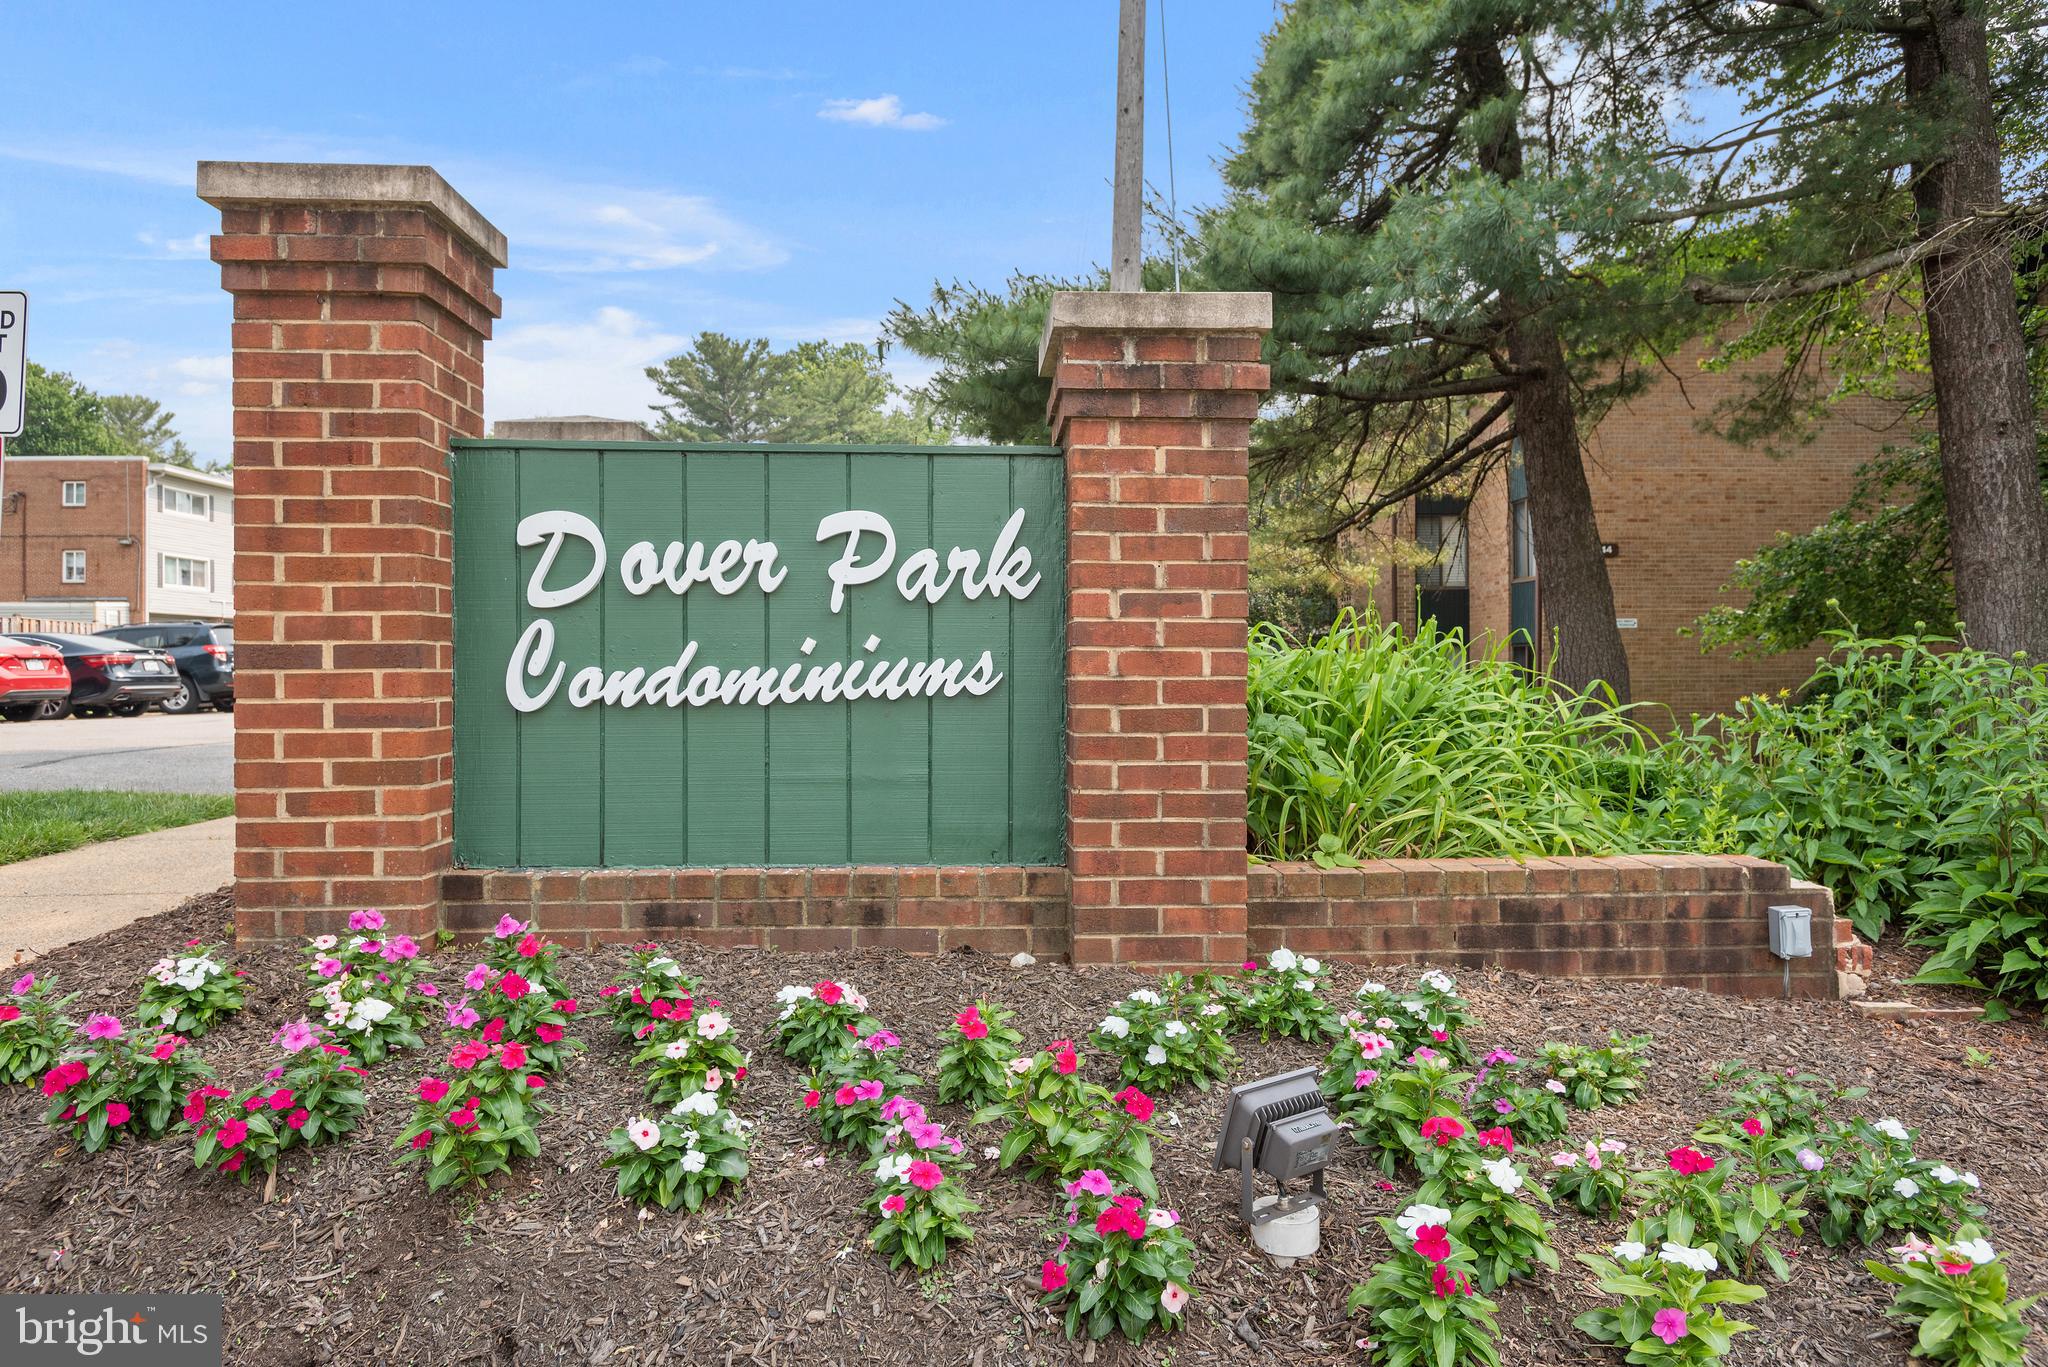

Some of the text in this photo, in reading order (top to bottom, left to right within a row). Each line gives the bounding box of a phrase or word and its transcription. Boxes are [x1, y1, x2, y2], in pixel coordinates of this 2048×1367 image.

[516, 507, 1042, 614] Dover Park
[505, 618, 1004, 713] Condominiums
